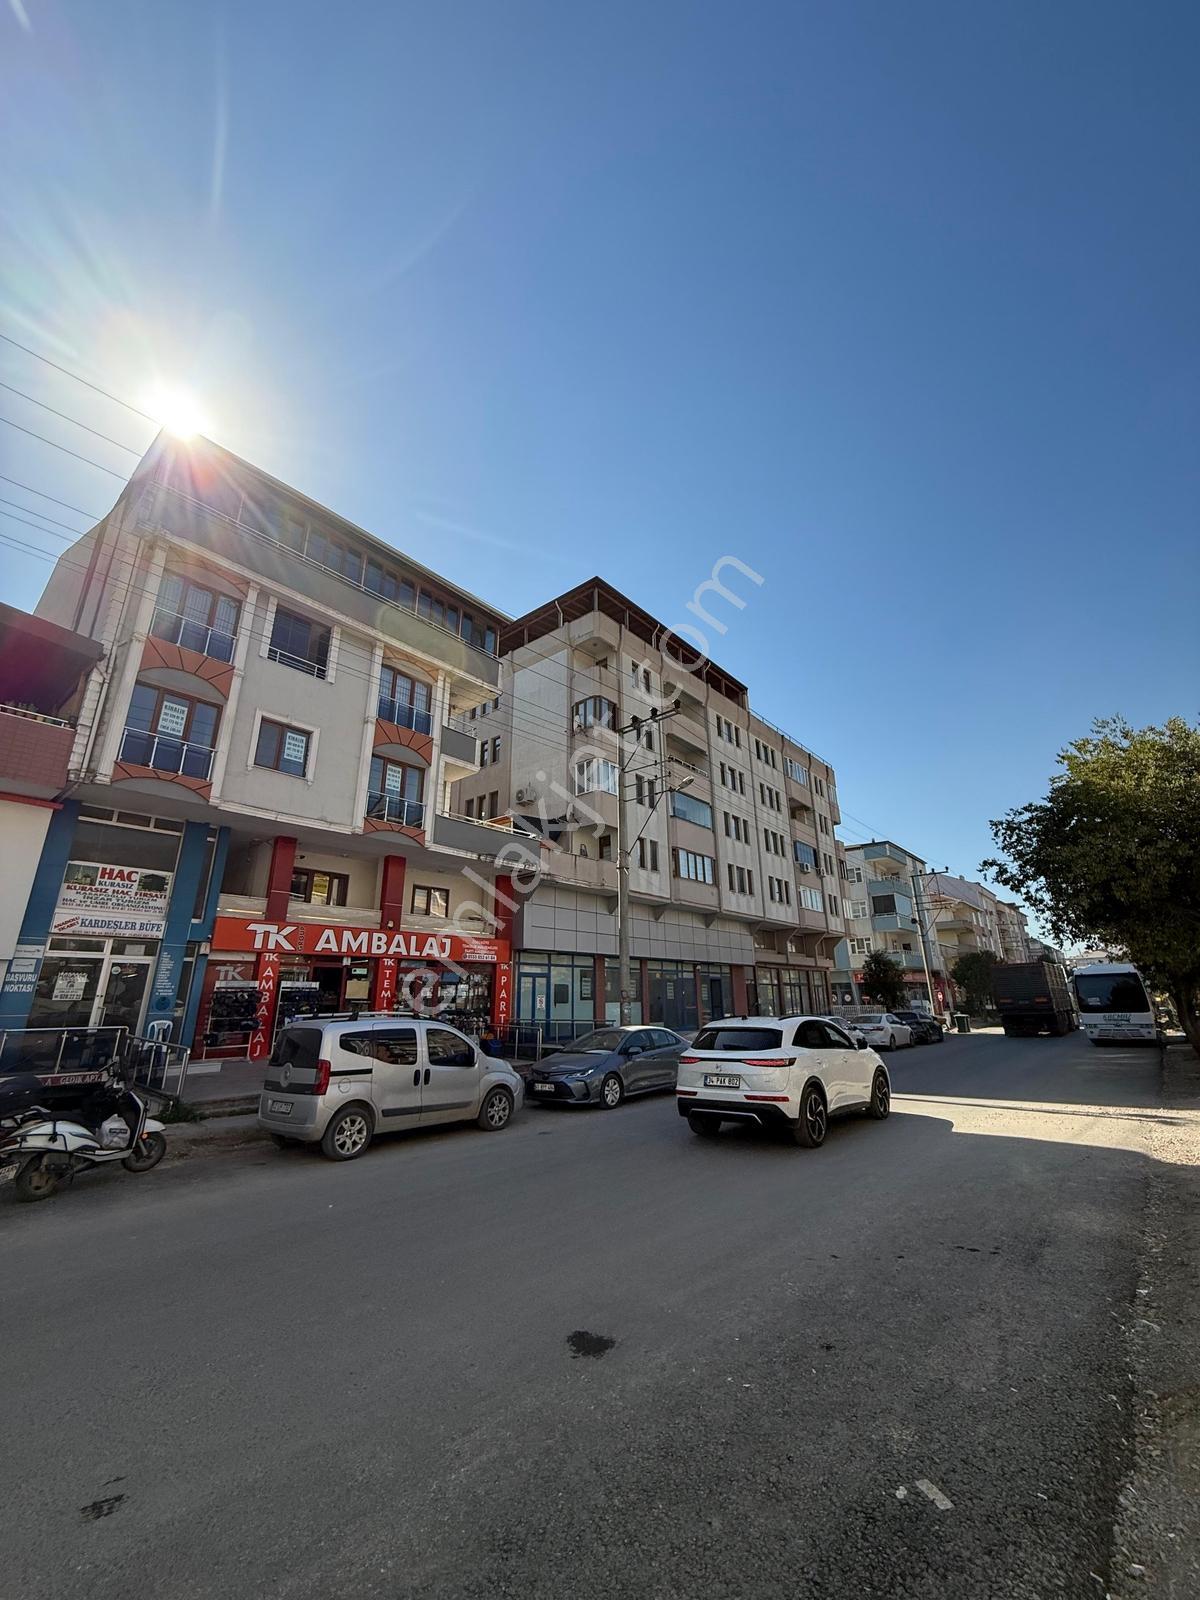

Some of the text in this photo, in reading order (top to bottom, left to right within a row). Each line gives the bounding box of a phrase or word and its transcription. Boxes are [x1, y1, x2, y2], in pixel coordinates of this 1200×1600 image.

[99, 867, 139, 883] HAC
[97, 880, 134, 890] KURASIZ
[112, 889, 132, 897] HAC
[80, 918, 162, 933] KARDEŞLER BÜFE
[246, 923, 297, 951] TK
[315, 928, 452, 958] AMBALAJ
[263, 952, 279, 962] TK
[215, 965, 246, 981] TK
[4, 984, 33, 993] NOKTASI
